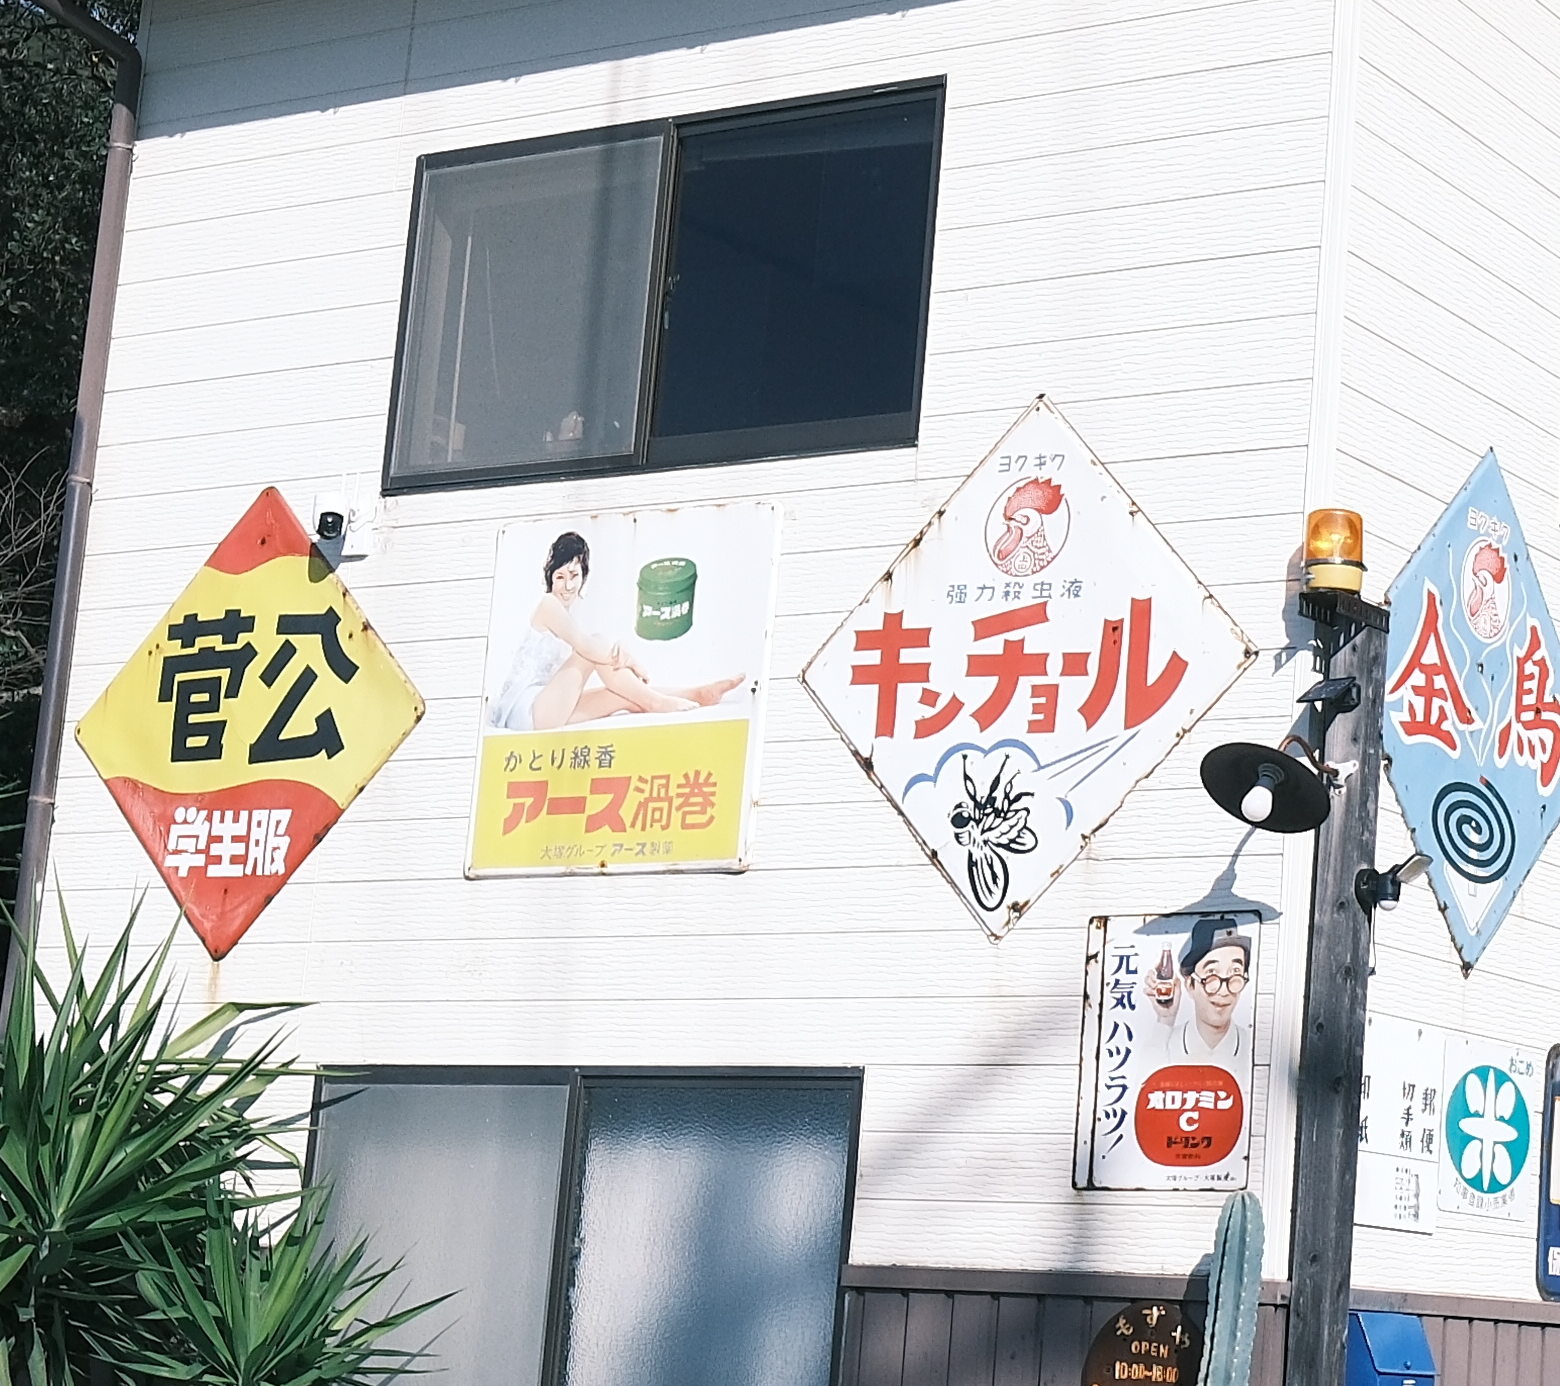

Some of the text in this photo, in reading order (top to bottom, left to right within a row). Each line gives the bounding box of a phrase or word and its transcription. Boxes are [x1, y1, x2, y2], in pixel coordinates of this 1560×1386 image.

[850, 597, 1189, 740] キンチョール
[157, 605, 360, 765] 菅公
[504, 743, 616, 772] かとり線香
[502, 769, 718, 836] アース渦巻
[164, 806, 293, 878] 学生服
[1508, 1056, 1534, 1078] おこめ
[1146, 1090, 1234, 1110] オロナミン
[1178, 1111, 1200, 1132] C
[1166, 1135, 1213, 1149] ドリンク
[1130, 1340, 1169, 1359] OPEN
